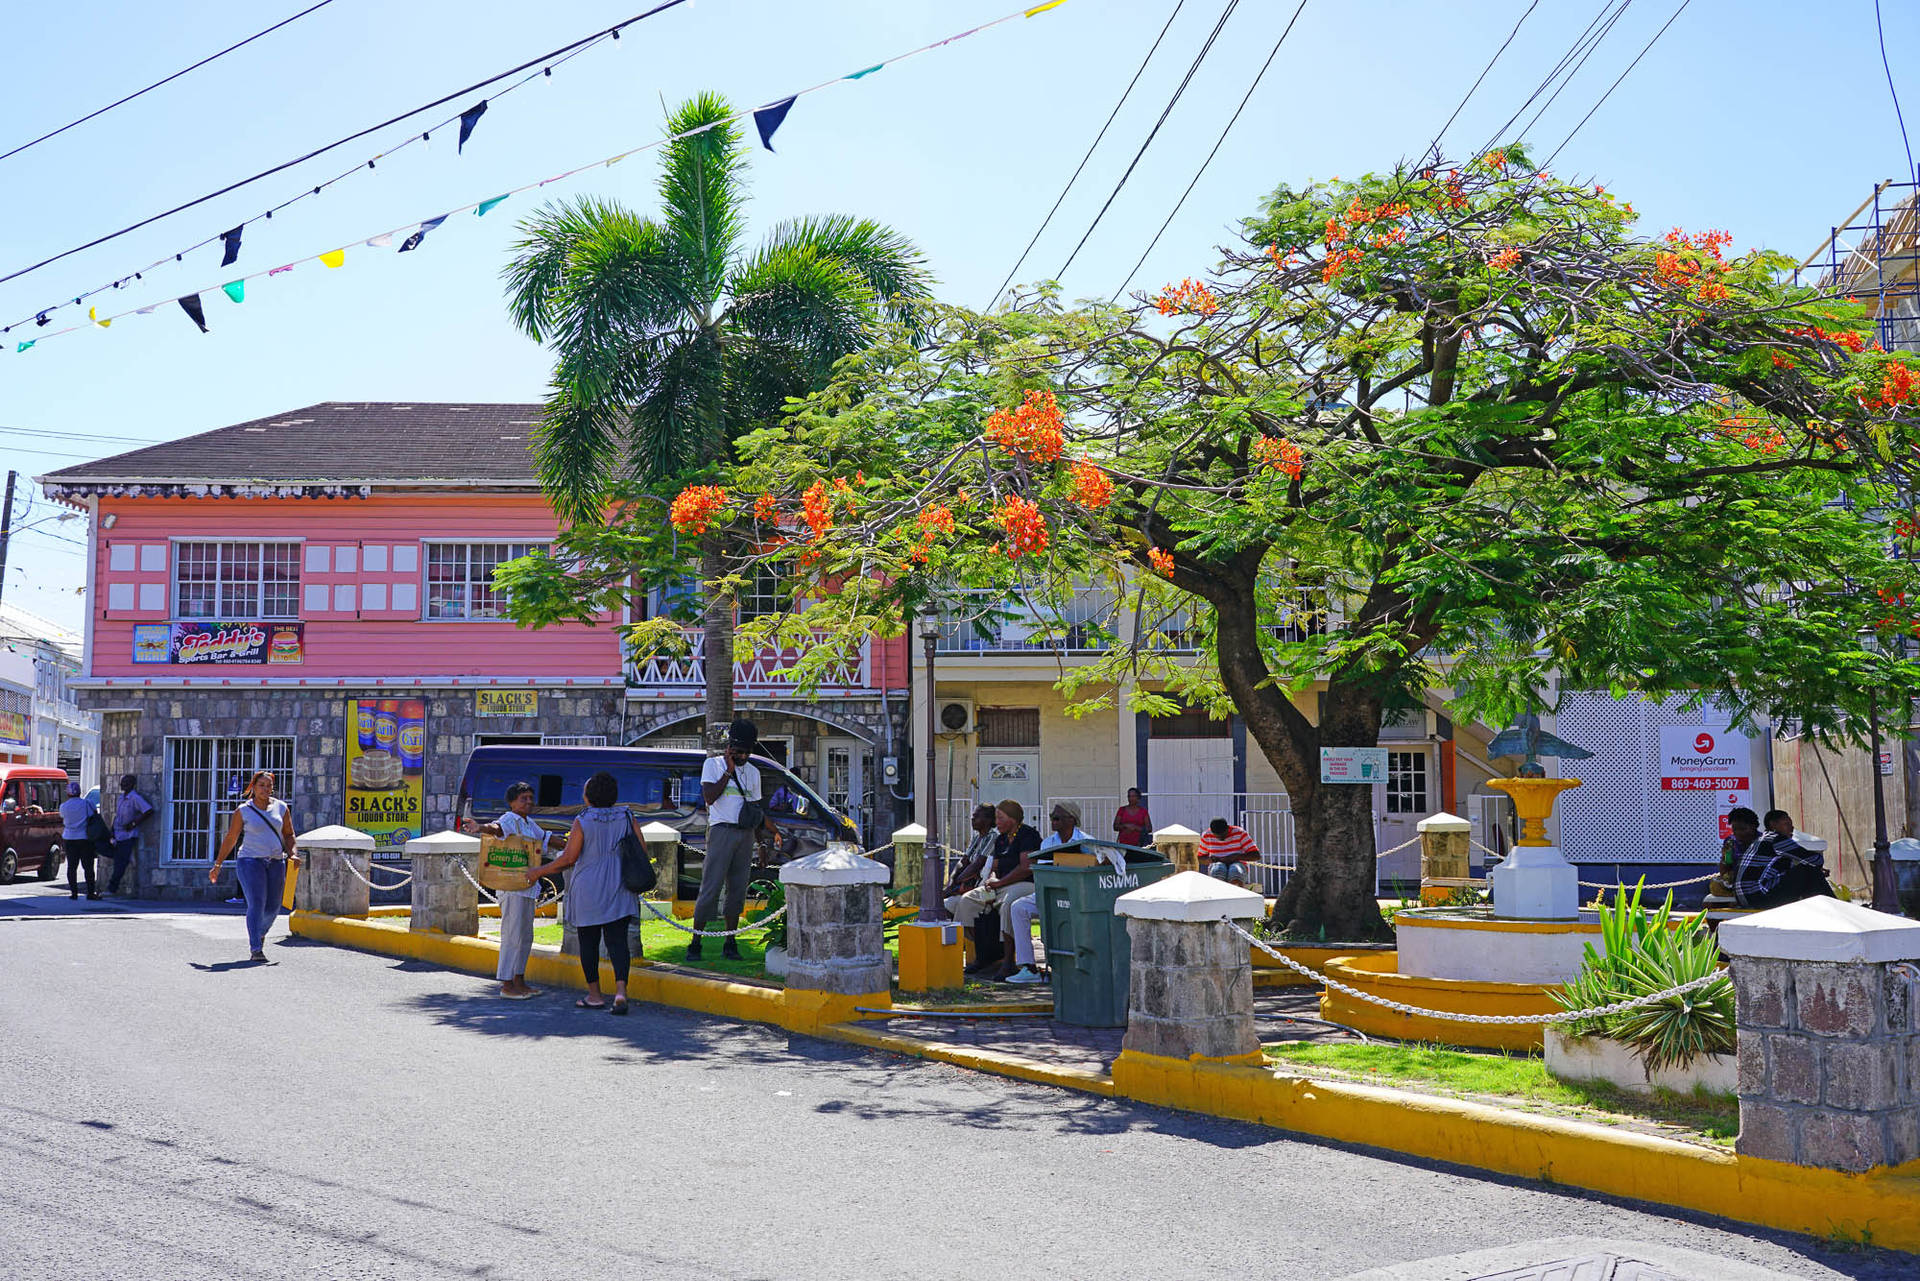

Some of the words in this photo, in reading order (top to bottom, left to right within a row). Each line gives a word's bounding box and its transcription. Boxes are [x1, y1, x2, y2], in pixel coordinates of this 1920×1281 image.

[179, 627, 266, 658] Teddy's
[178, 653, 209, 664] Sports
[210, 651, 228, 659] Bar
[239, 648, 260, 657] Grill
[481, 693, 532, 705] SLACK'S
[1671, 756, 1736, 767] MoneyGram
[1671, 779, 1739, 789] 869-469-5007
[350, 795, 418, 812] SLACK'S
[357, 812, 384, 822] LIQUOR
[386, 812, 409, 822] STORE
[489, 853, 511, 862] Green
[512, 854, 528, 864] Bag
[1099, 873, 1139, 889] NSWMA
